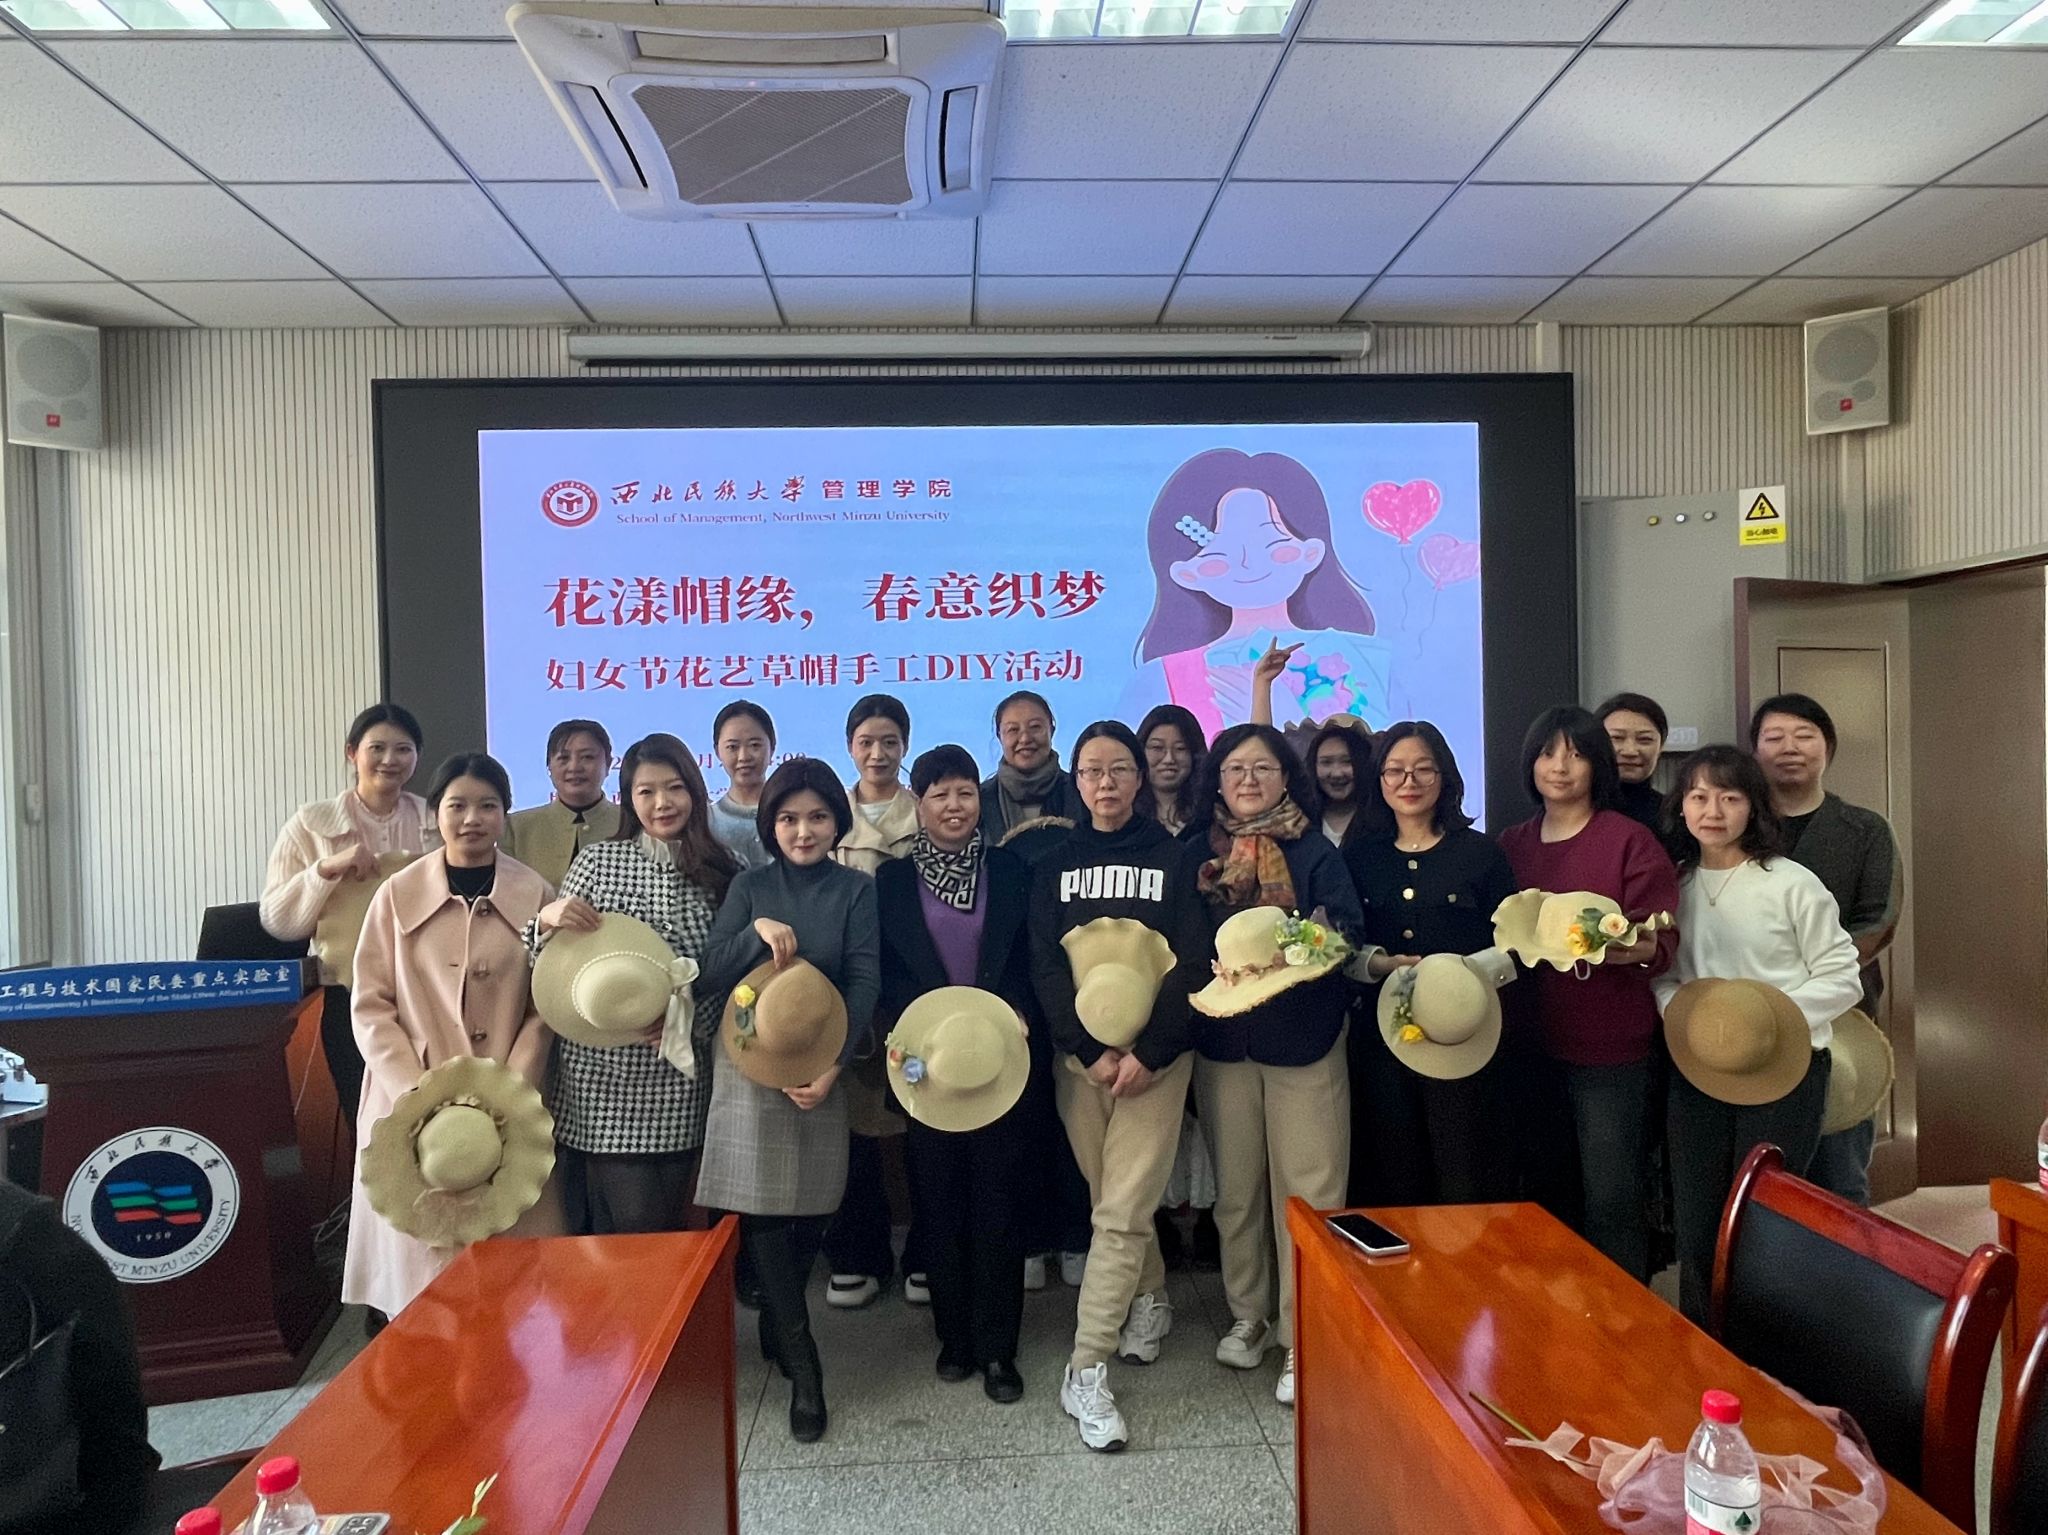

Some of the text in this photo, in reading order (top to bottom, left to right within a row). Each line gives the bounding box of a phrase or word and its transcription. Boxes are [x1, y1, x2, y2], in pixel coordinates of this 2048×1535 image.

[616, 509, 950, 525] School of Management, Northwest Minzu University
[546, 649, 1083, 692] 妇女节花艺草帽手工DIY活动
[1060, 865, 1164, 902] PUMA
[131, 1198, 231, 1276] MINZU UNIVERSITY
